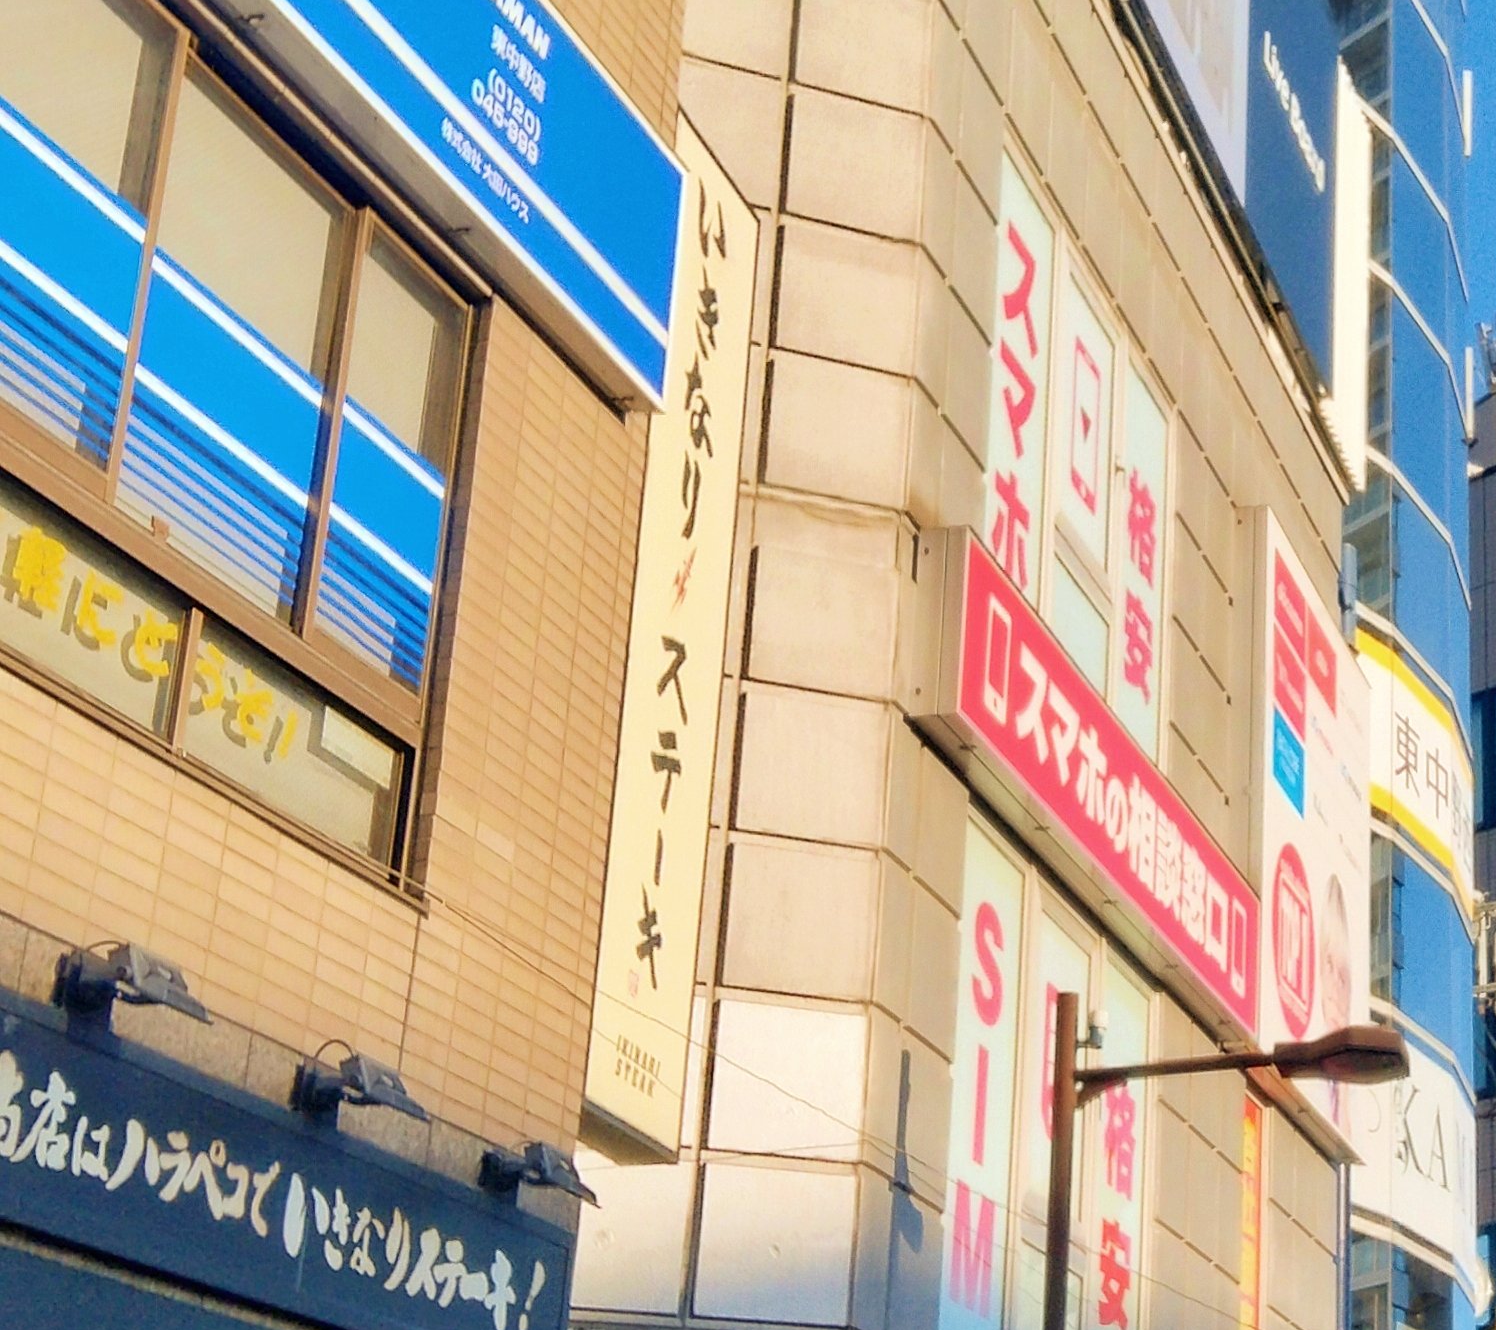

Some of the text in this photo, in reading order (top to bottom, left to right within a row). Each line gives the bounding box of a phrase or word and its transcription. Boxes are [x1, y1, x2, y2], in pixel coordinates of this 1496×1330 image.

[487, 68, 542, 143] (0120)
[1263, 30, 1291, 112] Live
[992, 218, 1039, 593] スマホ
[635, 177, 728, 992] いきなり ステーキ
[1121, 466, 1159, 707] 格安
[1014, 640, 1229, 973] スマホの相談窓口
[948, 900, 1005, 1319] SIM
